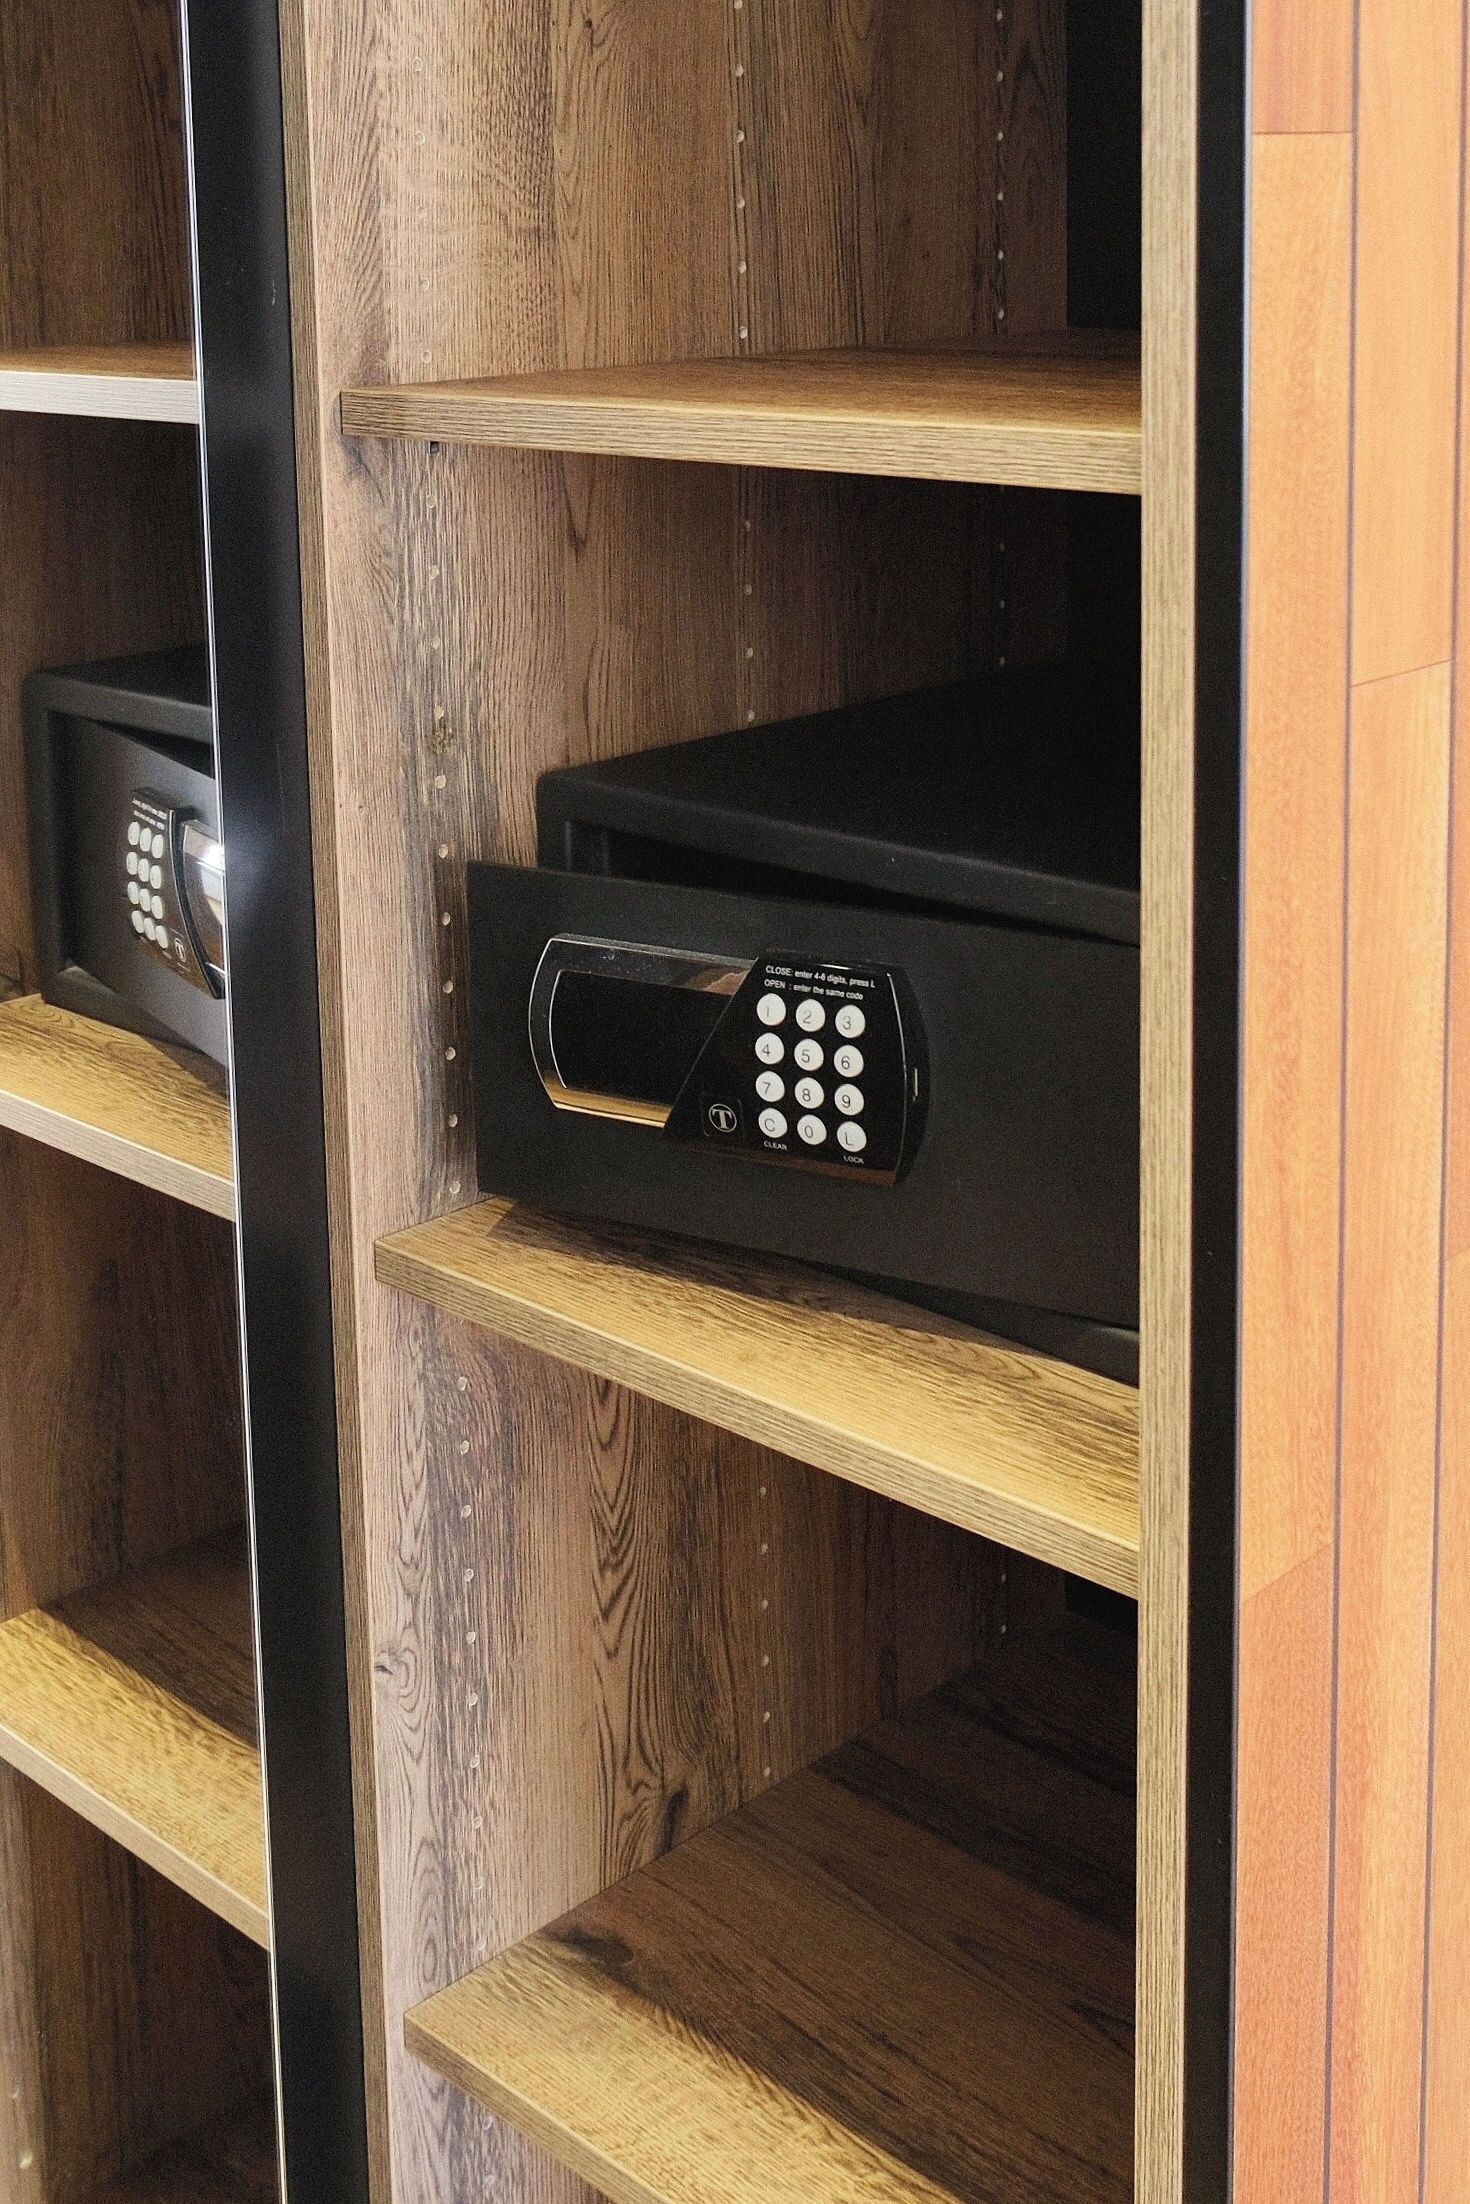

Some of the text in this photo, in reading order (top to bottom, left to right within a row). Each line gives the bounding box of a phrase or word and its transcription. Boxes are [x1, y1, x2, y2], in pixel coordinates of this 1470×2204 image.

[763, 978, 786, 989] OPEN
[793, 984, 812, 993] enter
[812, 986, 825, 995] the
[825, 988, 845, 998] same
[845, 991, 864, 1001] code
[794, 970, 813, 979] enter
[849, 978, 869, 987] press
[802, 1009, 812, 1025] 2
[842, 1014, 853, 1031] 3
[761, 1043, 851, 1071] 4 5 6
[762, 1081, 852, 1109] 7 8 9
[764, 1117, 776, 1132] C
[844, 1131, 854, 1147] L
[763, 1140, 789, 1152] CLEAR
[843, 1154, 865, 1165] LOCK
